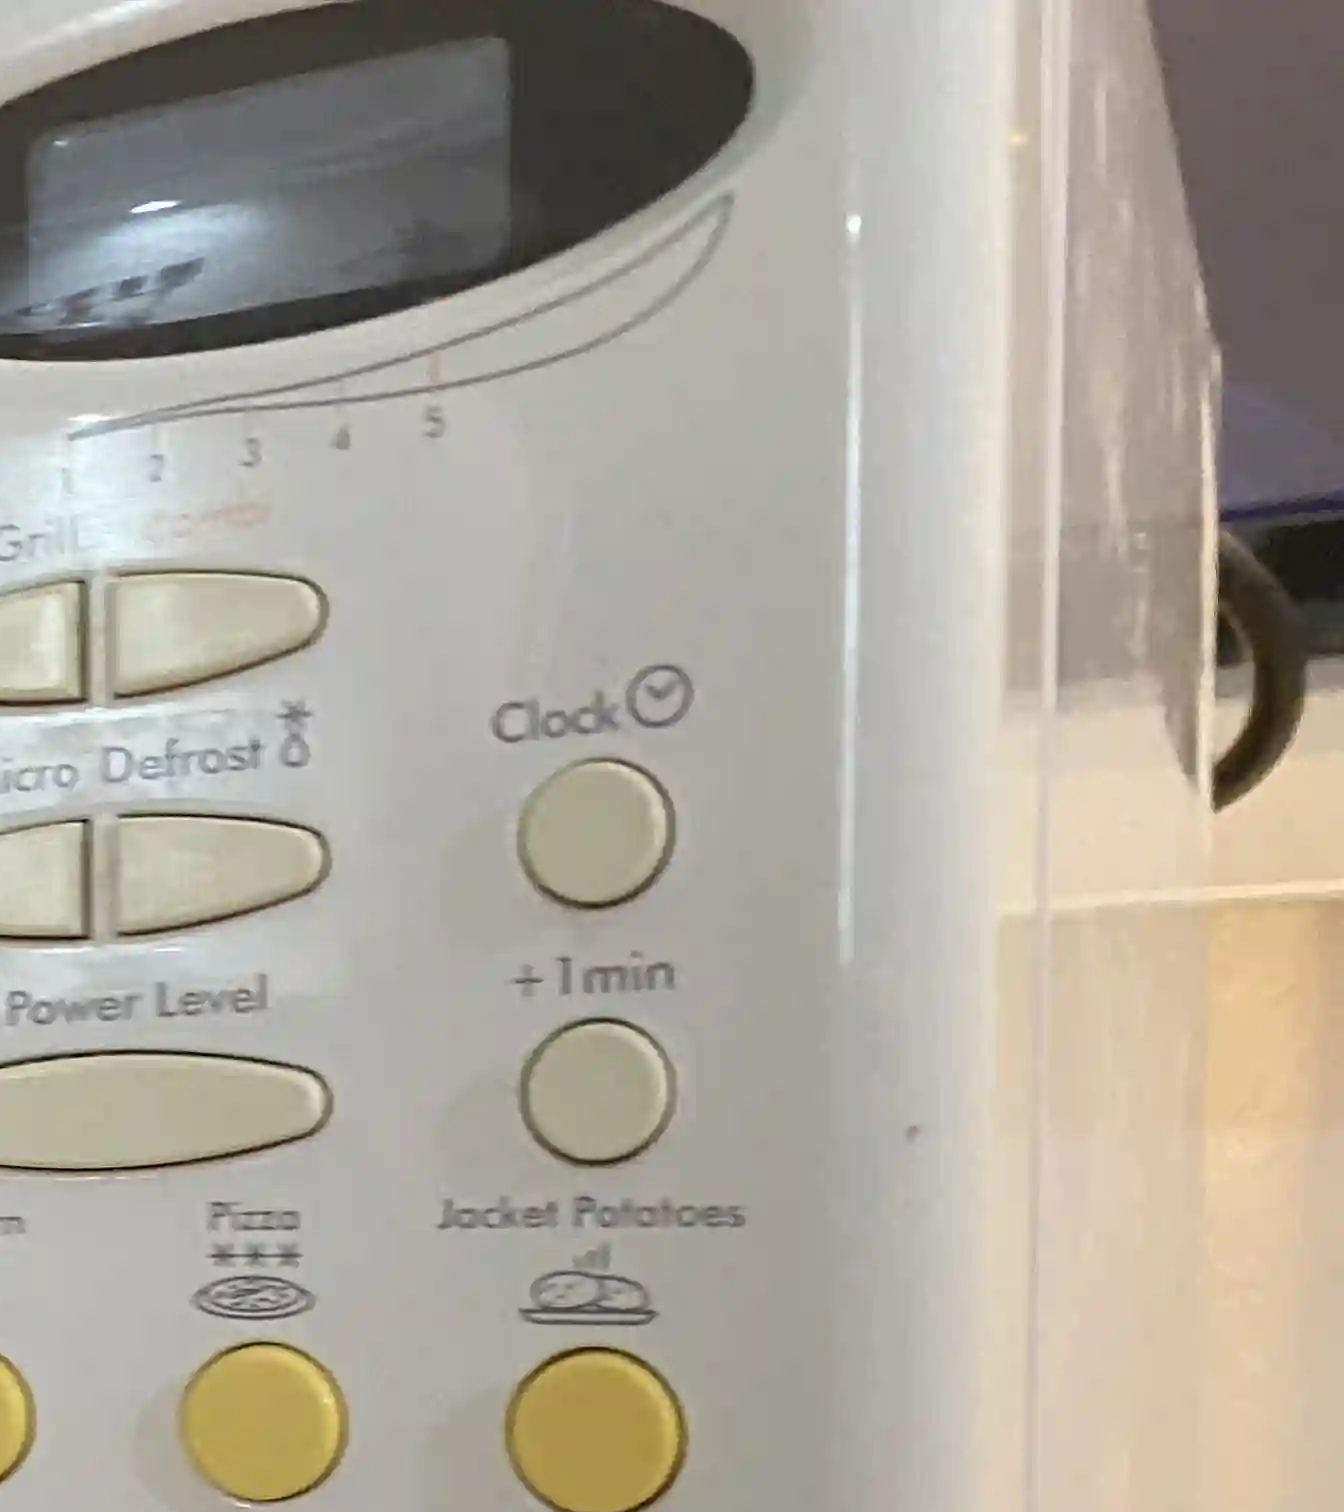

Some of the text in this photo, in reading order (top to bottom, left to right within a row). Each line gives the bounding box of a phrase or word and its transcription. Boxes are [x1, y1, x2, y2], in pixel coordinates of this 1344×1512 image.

[148, 453, 166, 482] 2
[239, 437, 263, 468] 3
[422, 404, 446, 440] 5
[489, 689, 619, 743] Clock
[98, 737, 265, 784] Defrost
[3, 973, 269, 1028] Power Level
[205, 1201, 301, 1232] Pizza
[435, 1195, 747, 1230] Jacket Potatoes
